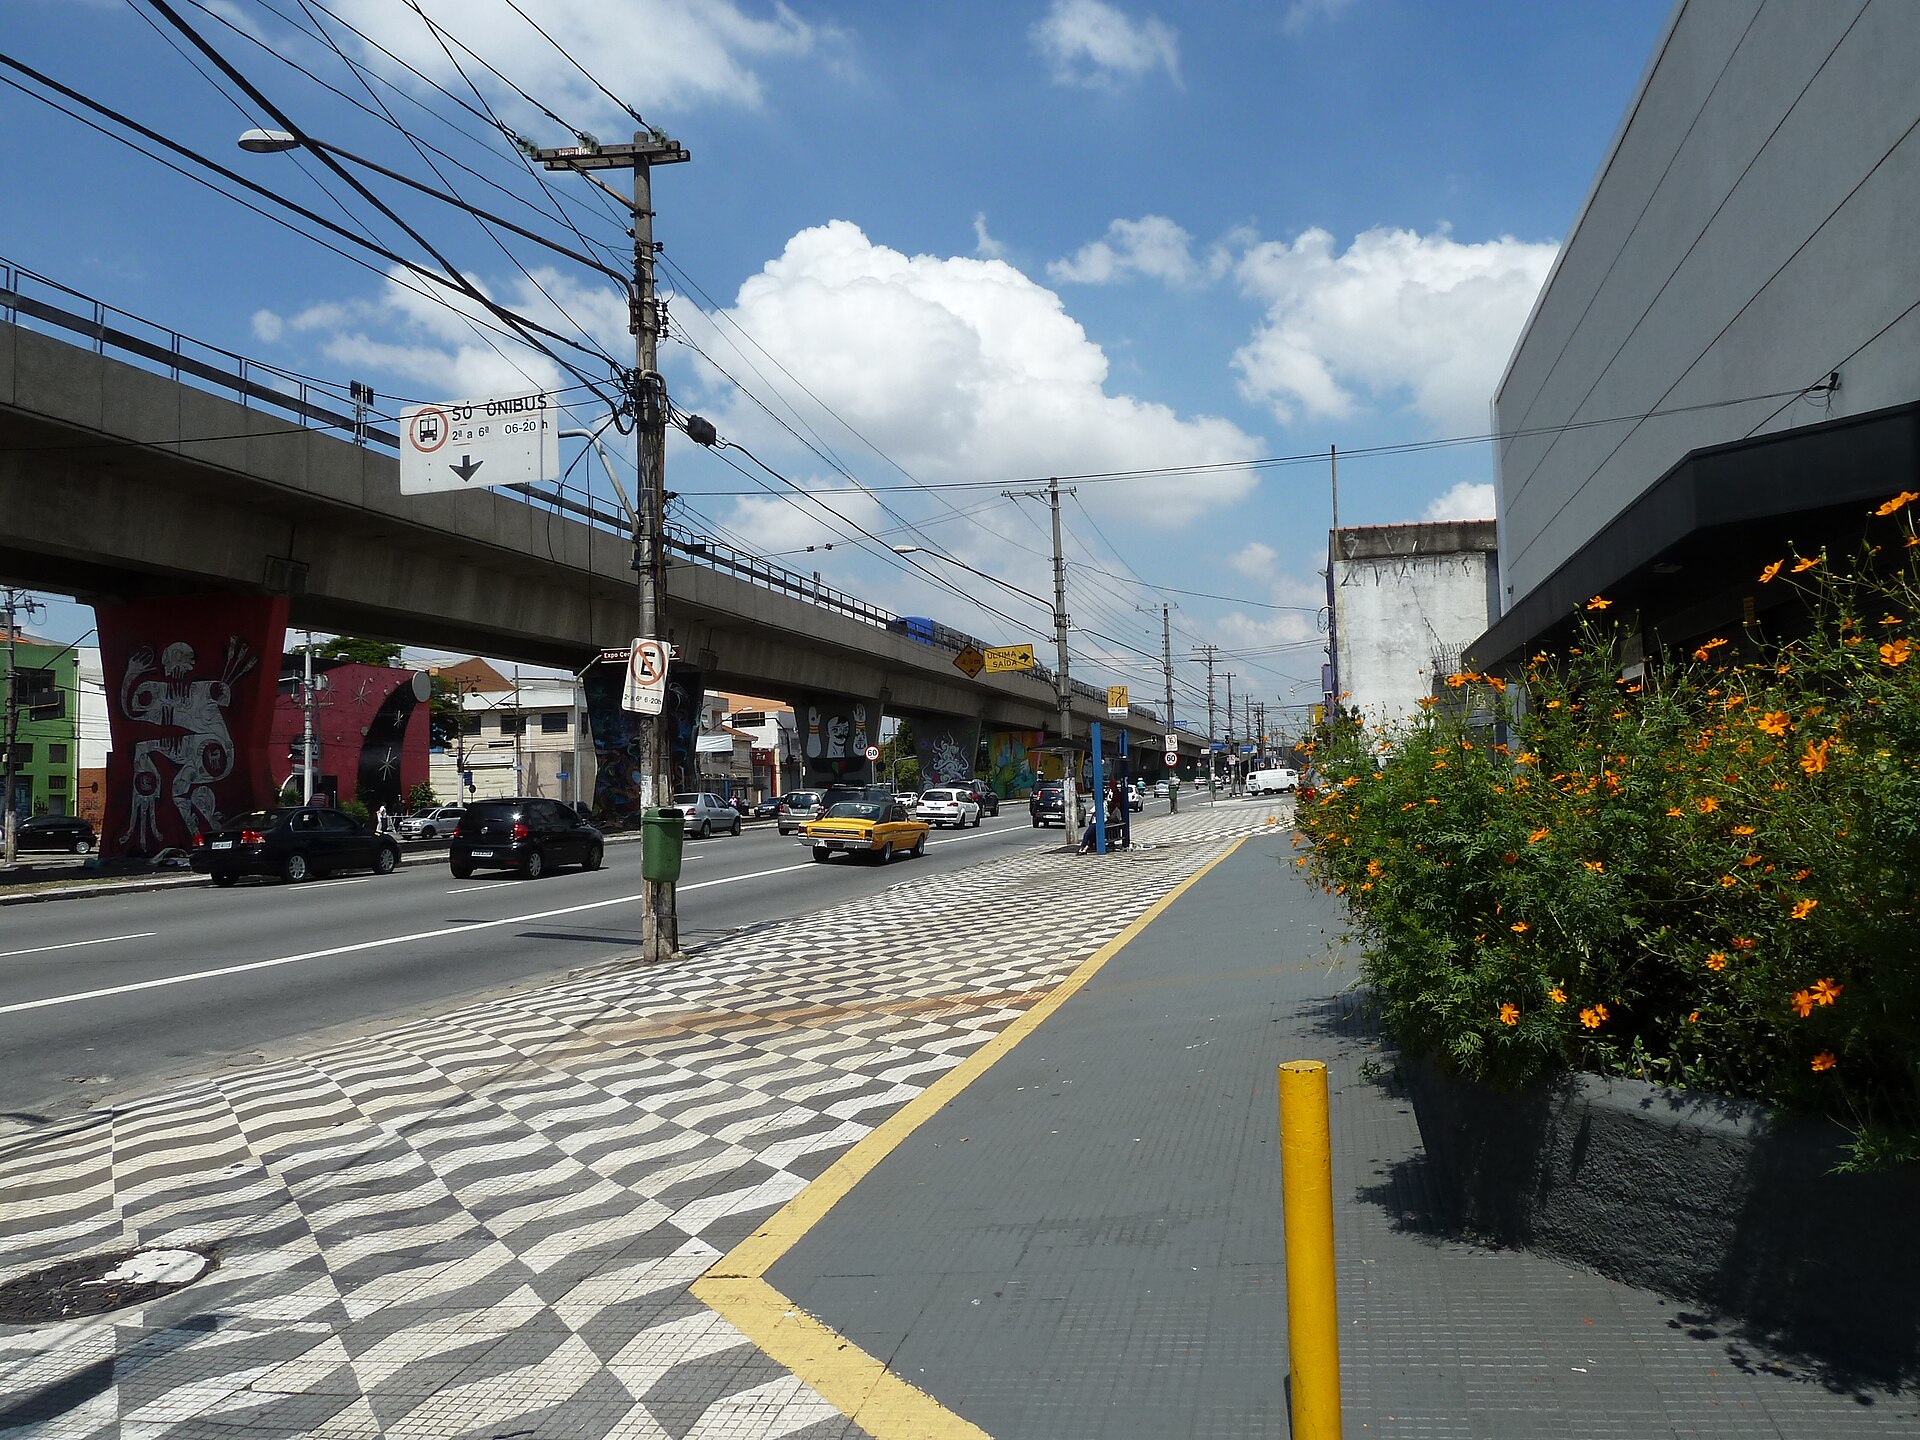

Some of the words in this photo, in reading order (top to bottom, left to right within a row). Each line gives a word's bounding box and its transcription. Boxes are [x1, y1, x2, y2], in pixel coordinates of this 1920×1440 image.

[451, 400, 473, 422] SÓ
[486, 394, 547, 417] ÔNIBUS
[466, 431, 473, 439] a
[604, 651, 618, 659] Expo
